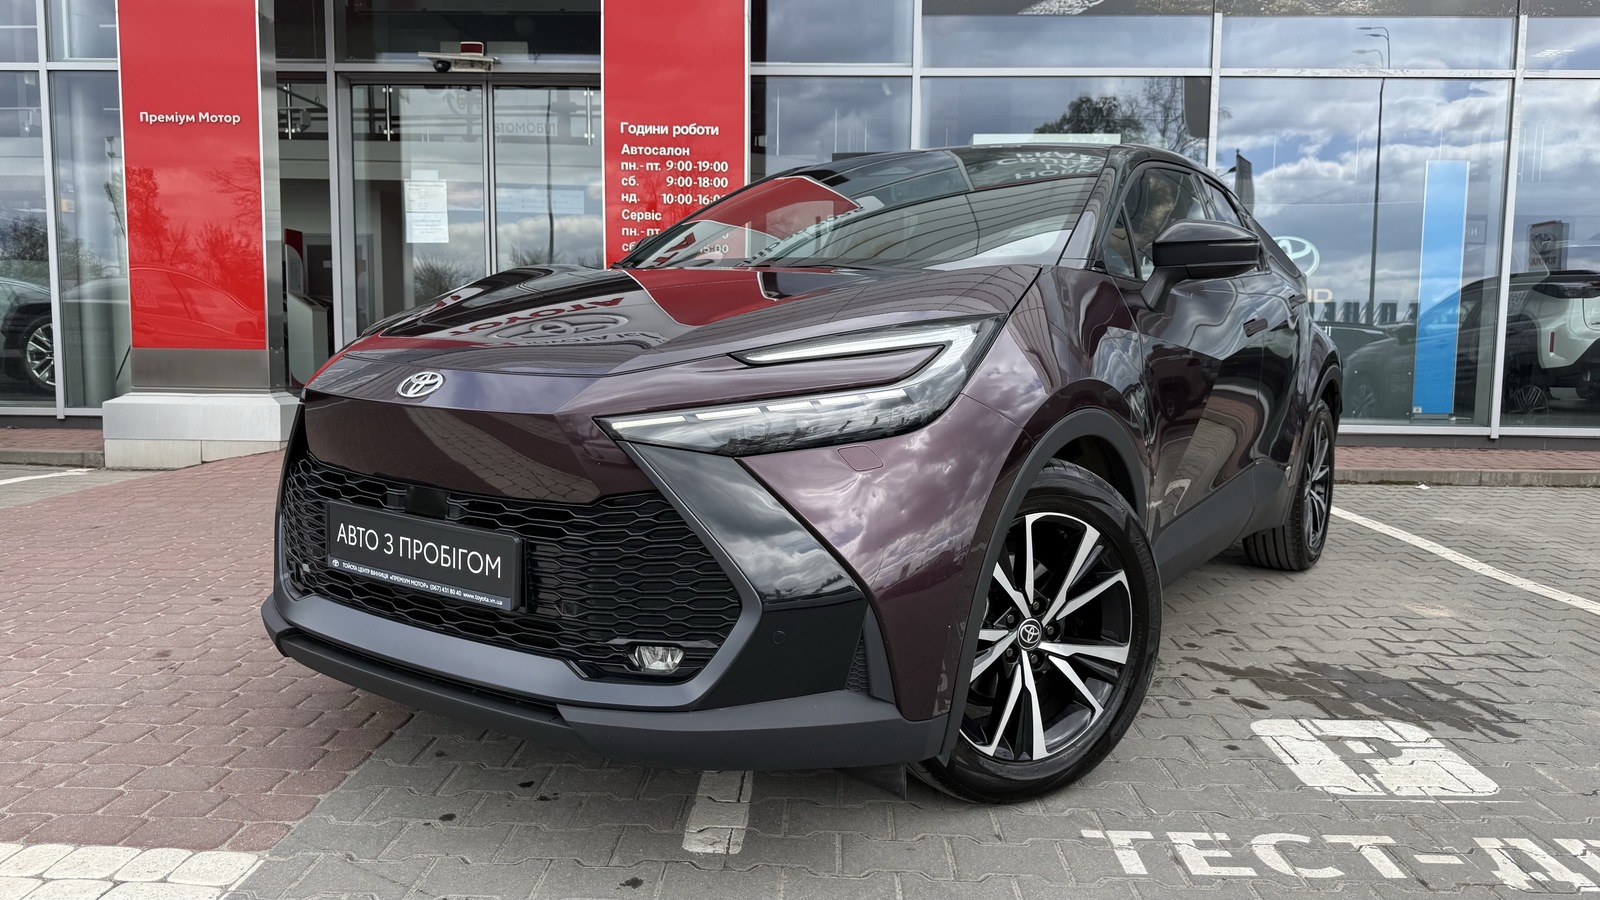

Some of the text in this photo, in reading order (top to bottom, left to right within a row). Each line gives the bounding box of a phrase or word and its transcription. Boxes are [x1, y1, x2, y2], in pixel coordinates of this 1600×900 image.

[139, 112, 240, 126] Преміум Мотор
[620, 122, 719, 138] Години роботи
[621, 144, 690, 156] Автосалон
[666, 160, 728, 172] 9:00-19:00
[621, 175, 728, 188] сб. 9:00-18:00
[621, 194, 727, 205] нд. 10:00-16:0
[621, 209, 662, 222] Сервіс
[336, 522, 501, 578] АВТО З ПРОБІГОМ
[430, 584, 441, 592] (067)
